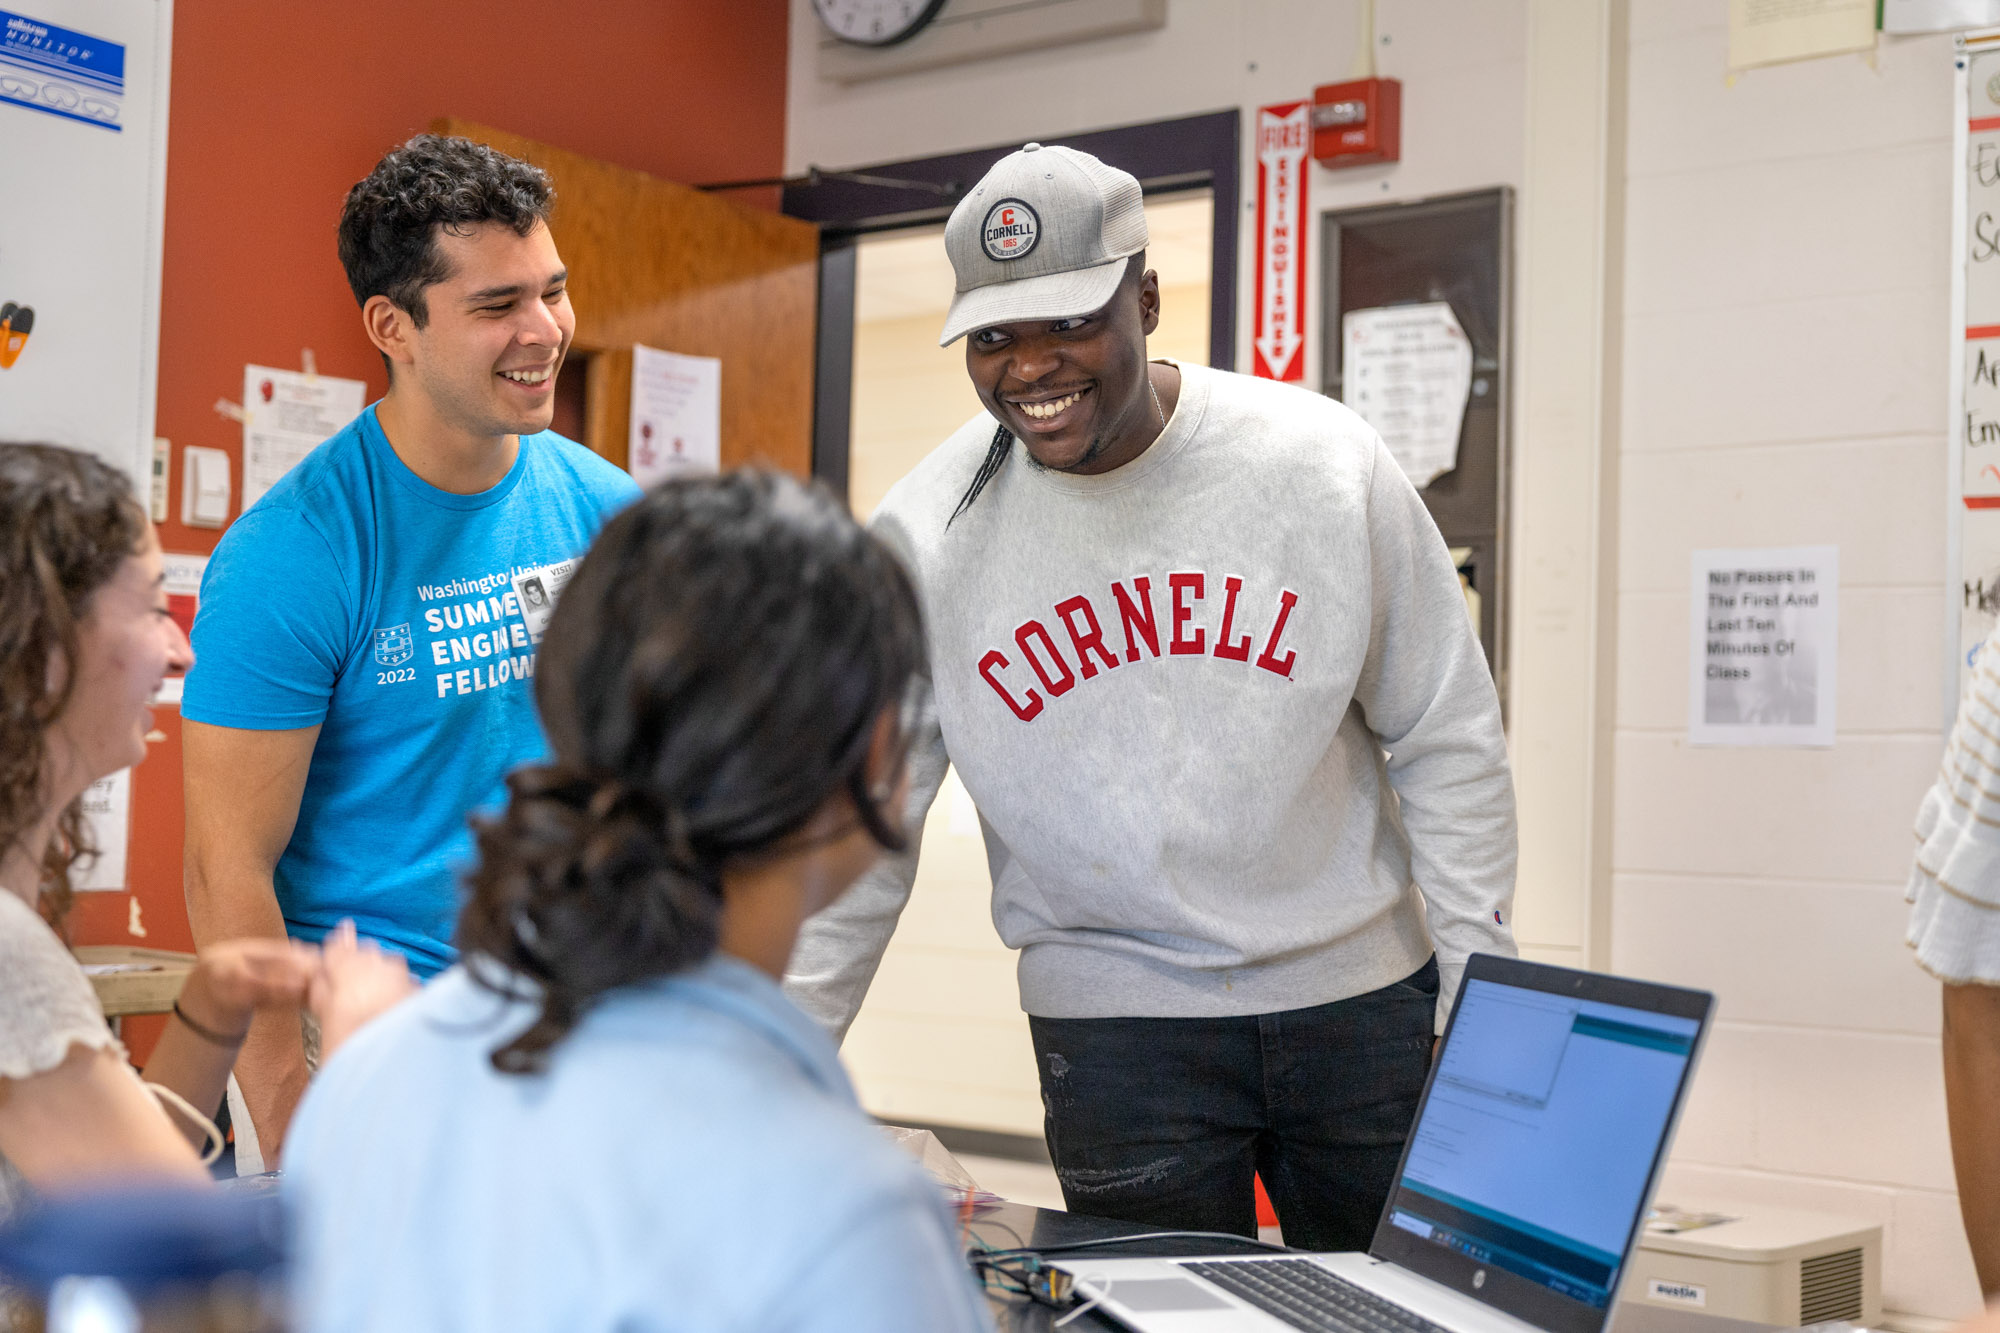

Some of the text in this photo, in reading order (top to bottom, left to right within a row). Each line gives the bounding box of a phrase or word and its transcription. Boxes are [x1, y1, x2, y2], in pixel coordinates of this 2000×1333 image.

[5, 29, 94, 60] MONITOR
[1263, 121, 1305, 151] FIRE
[1001, 208, 1015, 226] C
[986, 223, 1034, 242] CORNELL
[1002, 238, 1018, 249] 1865
[1271, 157, 1289, 358] EXTINGUISHER
[550, 564, 572, 576] VISIT
[1709, 568, 1816, 586] No Passes In
[1708, 592, 1819, 608] The First And
[425, 592, 520, 632] SUMME
[1707, 616, 1776, 633] Last Ten
[977, 572, 1299, 723] CORNELL
[1706, 639, 1796, 656] Minutes Of
[376, 667, 417, 686] 2022
[436, 654, 537, 698] FELLOW
[1705, 664, 1751, 680] Class
[1657, 1284, 1697, 1298] austin
